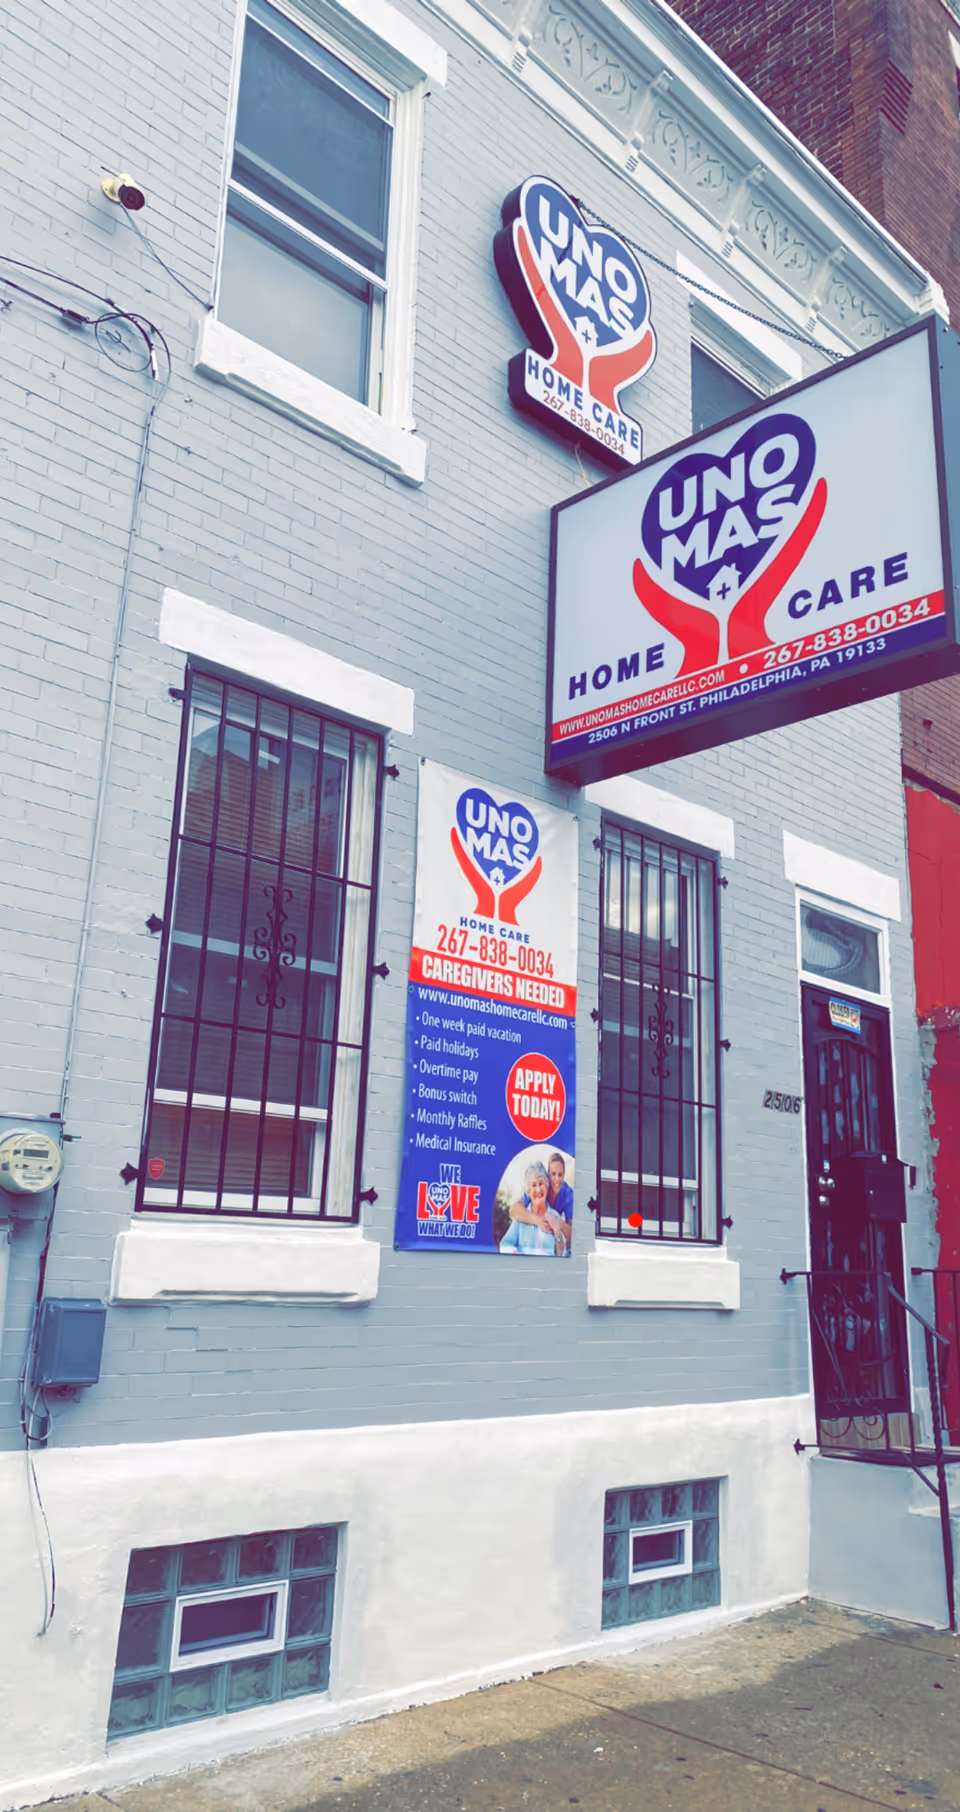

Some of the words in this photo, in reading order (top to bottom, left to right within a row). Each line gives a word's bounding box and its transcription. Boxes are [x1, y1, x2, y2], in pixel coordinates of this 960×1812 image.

[539, 194, 637, 304] UNO
[540, 236, 634, 334] MAS
[528, 355, 583, 411] HOME
[592, 403, 639, 450] CARE
[543, 390, 625, 455] 267-838-0034
[659, 433, 799, 531] UNO
[660, 484, 796, 575] MAS
[568, 643, 665, 700] HOME
[788, 552, 909, 619] CARE
[559, 670, 725, 736] WWW.UNOMASHOMECARELLC.COM
[763, 598, 931, 669] 267-838-0034
[588, 726, 618, 744] 2506
[621, 722, 631, 734] N
[634, 707, 676, 730] FRONT
[679, 701, 697, 715] ST.
[700, 666, 807, 709] PHILADELPHIA,
[811, 657, 831, 672] PA
[836, 638, 887, 663] 19133
[465, 798, 533, 844] UNO
[466, 827, 531, 871] MAS
[437, 924, 554, 978] 267-838-0034
[460, 916, 495, 935] HOME
[499, 928, 530, 944] CARE
[422, 955, 513, 997] CAREGIVERS
[516, 977, 565, 1008] NEEDED
[418, 987, 568, 1030] www.unomashomecarellc.com
[422, 1011, 440, 1028] One
[442, 1018, 465, 1032] week
[467, 1022, 485, 1037] paid
[487, 1027, 522, 1044] vacation
[421, 1035, 441, 1052] Paid
[443, 1042, 479, 1060] holidays
[418, 1083, 447, 1100] Bonus
[449, 1089, 477, 1105] switch
[420, 1059, 461, 1079] Overtime
[463, 1069, 479, 1085] pay
[515, 1067, 556, 1095] APPLY
[417, 1108, 456, 1130] Monthly
[458, 1114, 487, 1131] Raffles
[512, 1094, 560, 1122] TODAY!
[416, 1133, 452, 1150] Medical
[454, 1136, 496, 1156] Insurance
[440, 1163, 461, 1184] WE
[418, 1221, 443, 1237] WHAT
[444, 1222, 460, 1238] WE
[460, 1223, 476, 1239] DO!
